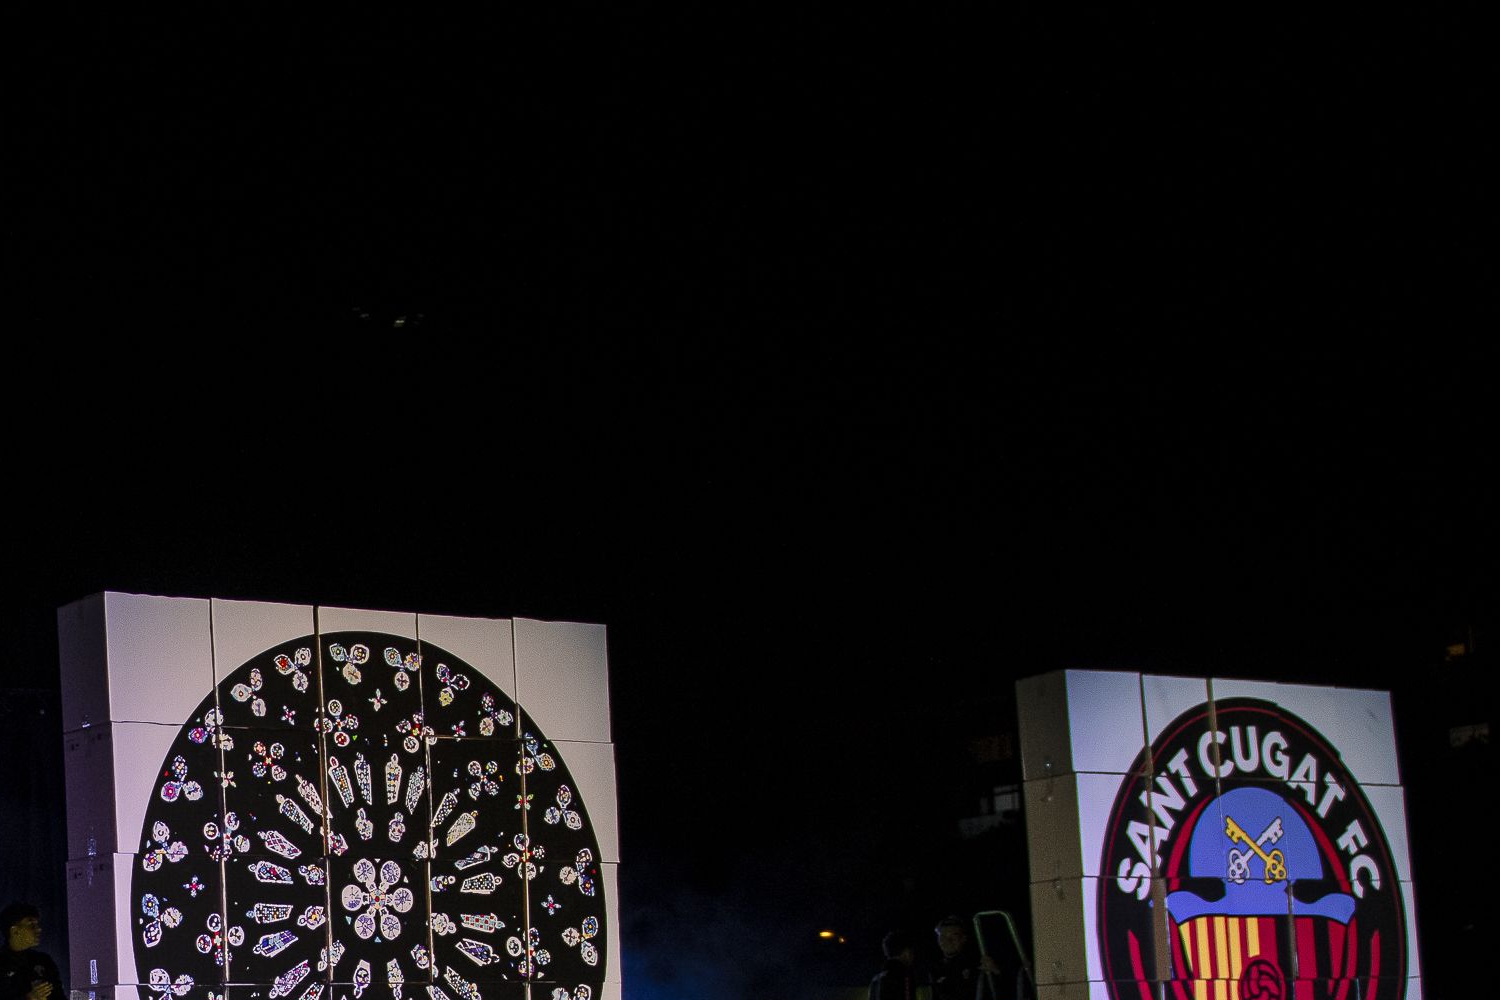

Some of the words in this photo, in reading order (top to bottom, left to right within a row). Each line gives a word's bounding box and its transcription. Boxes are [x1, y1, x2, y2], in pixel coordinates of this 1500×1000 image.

[1117, 749, 1198, 900] SANT
[1198, 726, 1346, 818] CUGAT
[1337, 820, 1381, 899] FC
